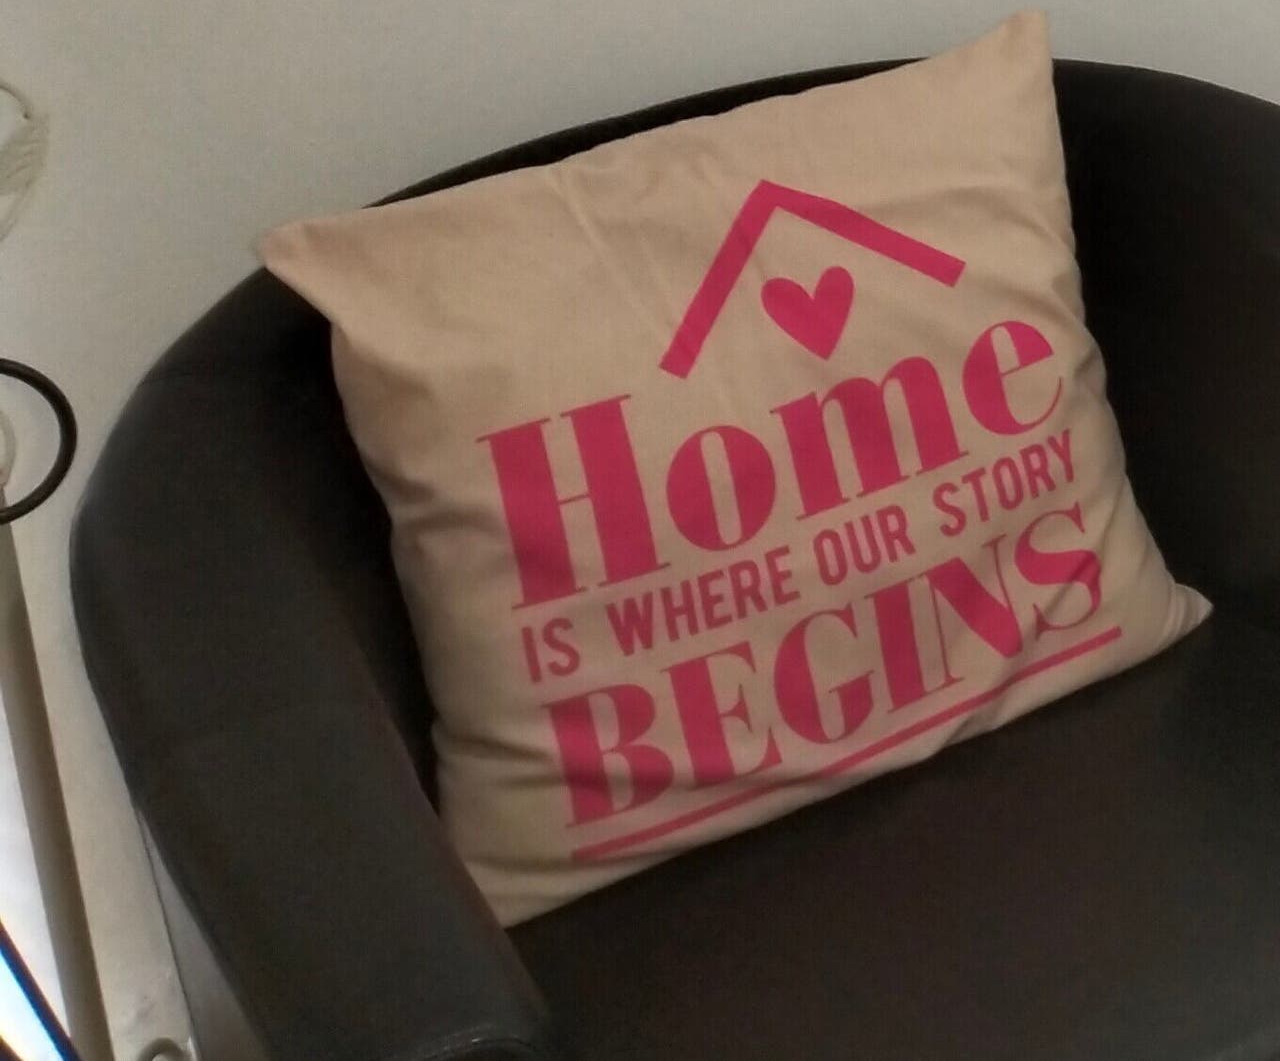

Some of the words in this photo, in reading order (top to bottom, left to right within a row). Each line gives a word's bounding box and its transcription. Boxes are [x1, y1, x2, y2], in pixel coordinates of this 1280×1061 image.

[477, 320, 1064, 609] Home
[522, 618, 581, 683] IS
[605, 548, 799, 657] WHERE
[813, 511, 916, 586] OUR
[933, 429, 1078, 536] STORY
[541, 503, 1102, 828] BEGINS
